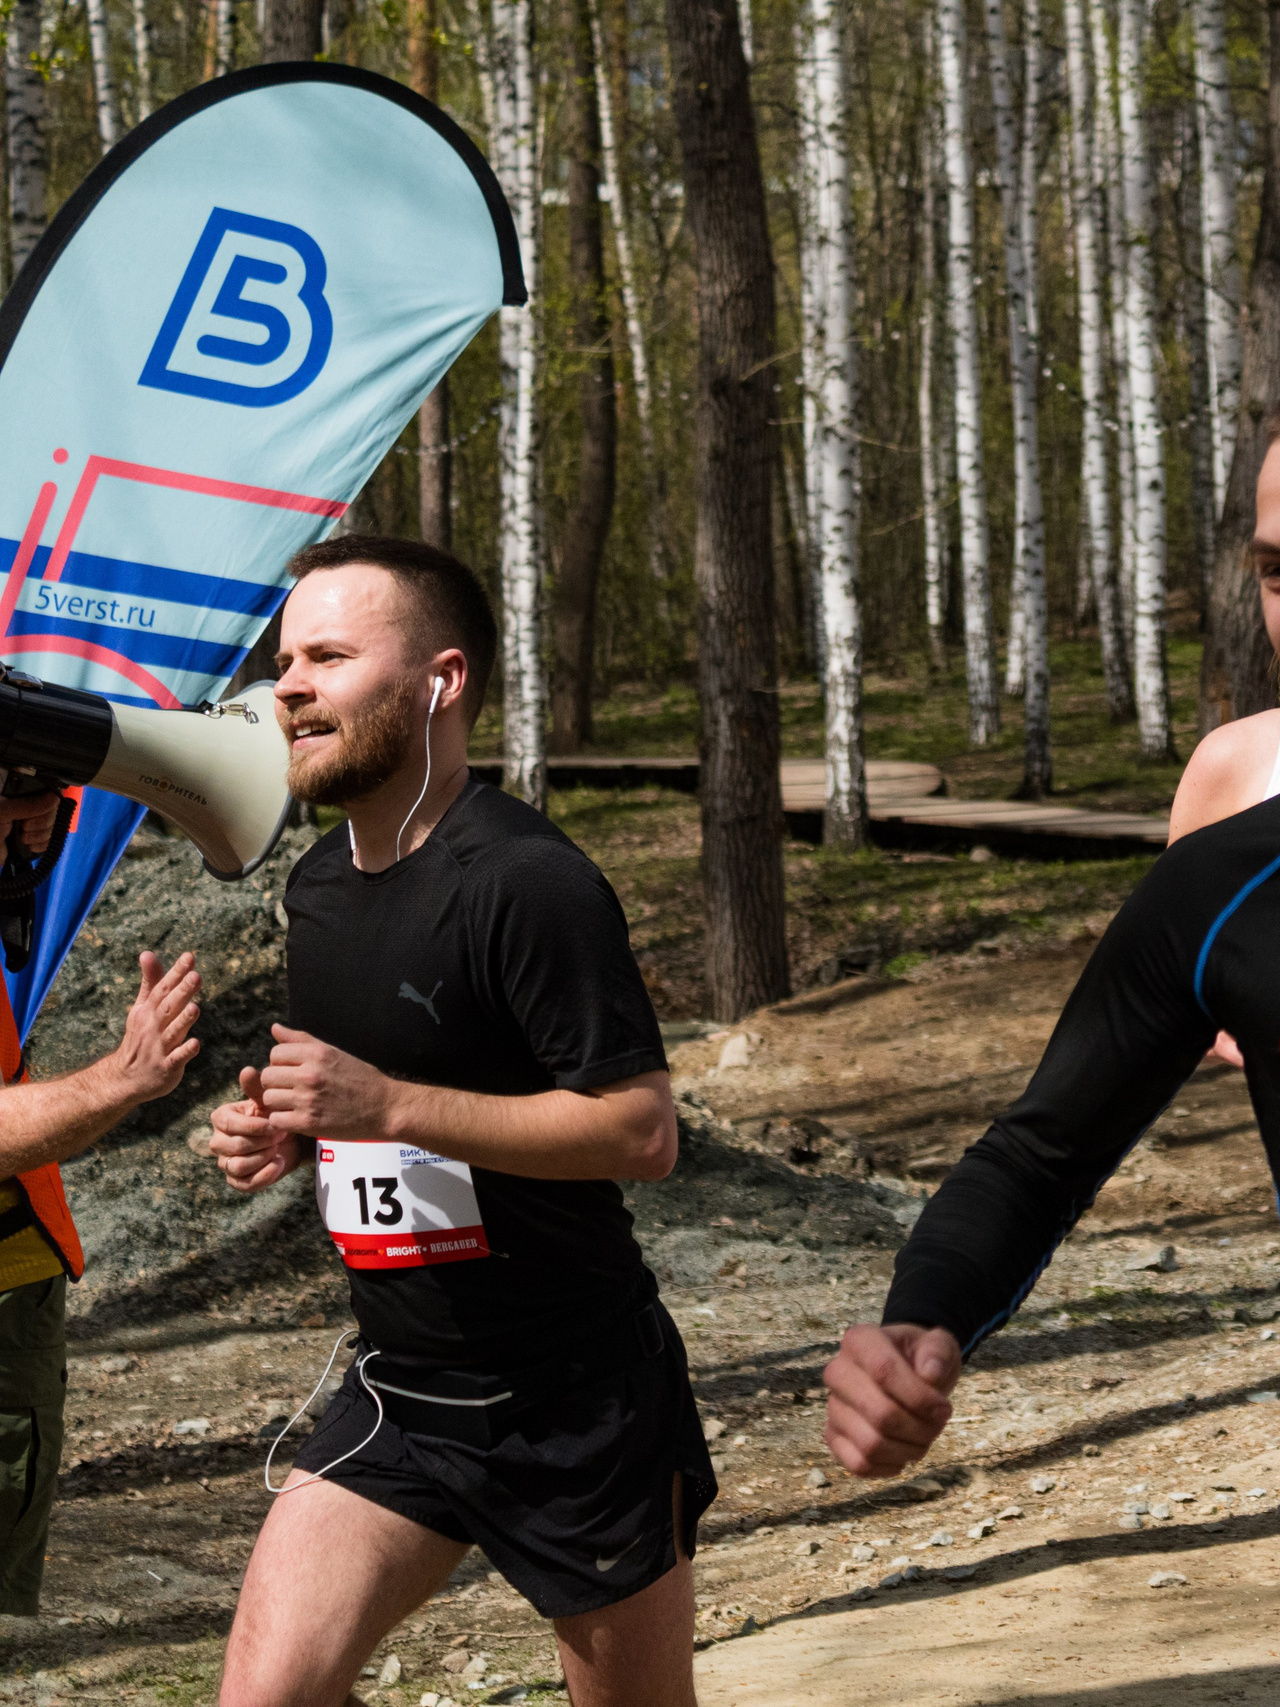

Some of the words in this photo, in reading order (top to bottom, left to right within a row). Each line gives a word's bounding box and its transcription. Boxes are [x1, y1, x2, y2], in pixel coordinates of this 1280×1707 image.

[34, 585, 156, 628] 5verst.ru
[352, 1177, 404, 1226] 13
[386, 1245, 422, 1257] BRIGHT
[430, 1238, 478, 1253] BERGAUER
